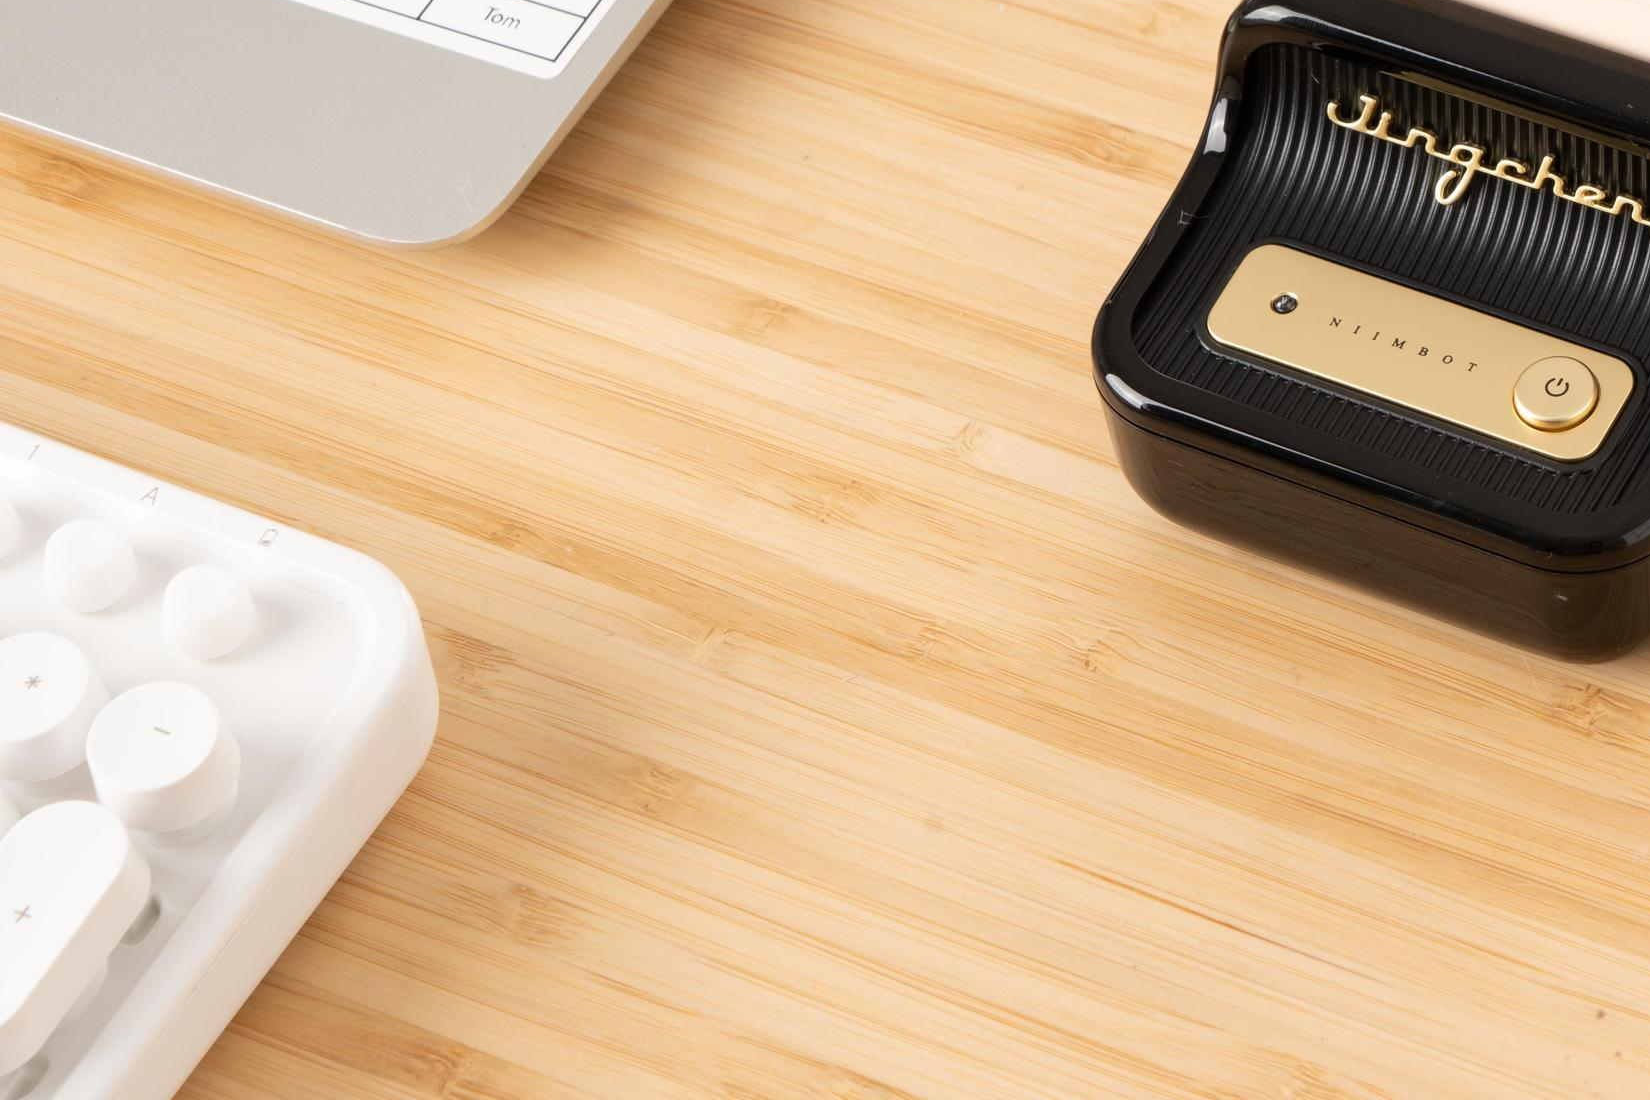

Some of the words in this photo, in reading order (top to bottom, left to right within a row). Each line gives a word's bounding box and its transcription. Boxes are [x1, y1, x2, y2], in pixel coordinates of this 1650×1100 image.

[484, 7, 521, 29] Tom
[1328, 315, 1480, 373] NIIMBOT
[139, 486, 159, 506] A
